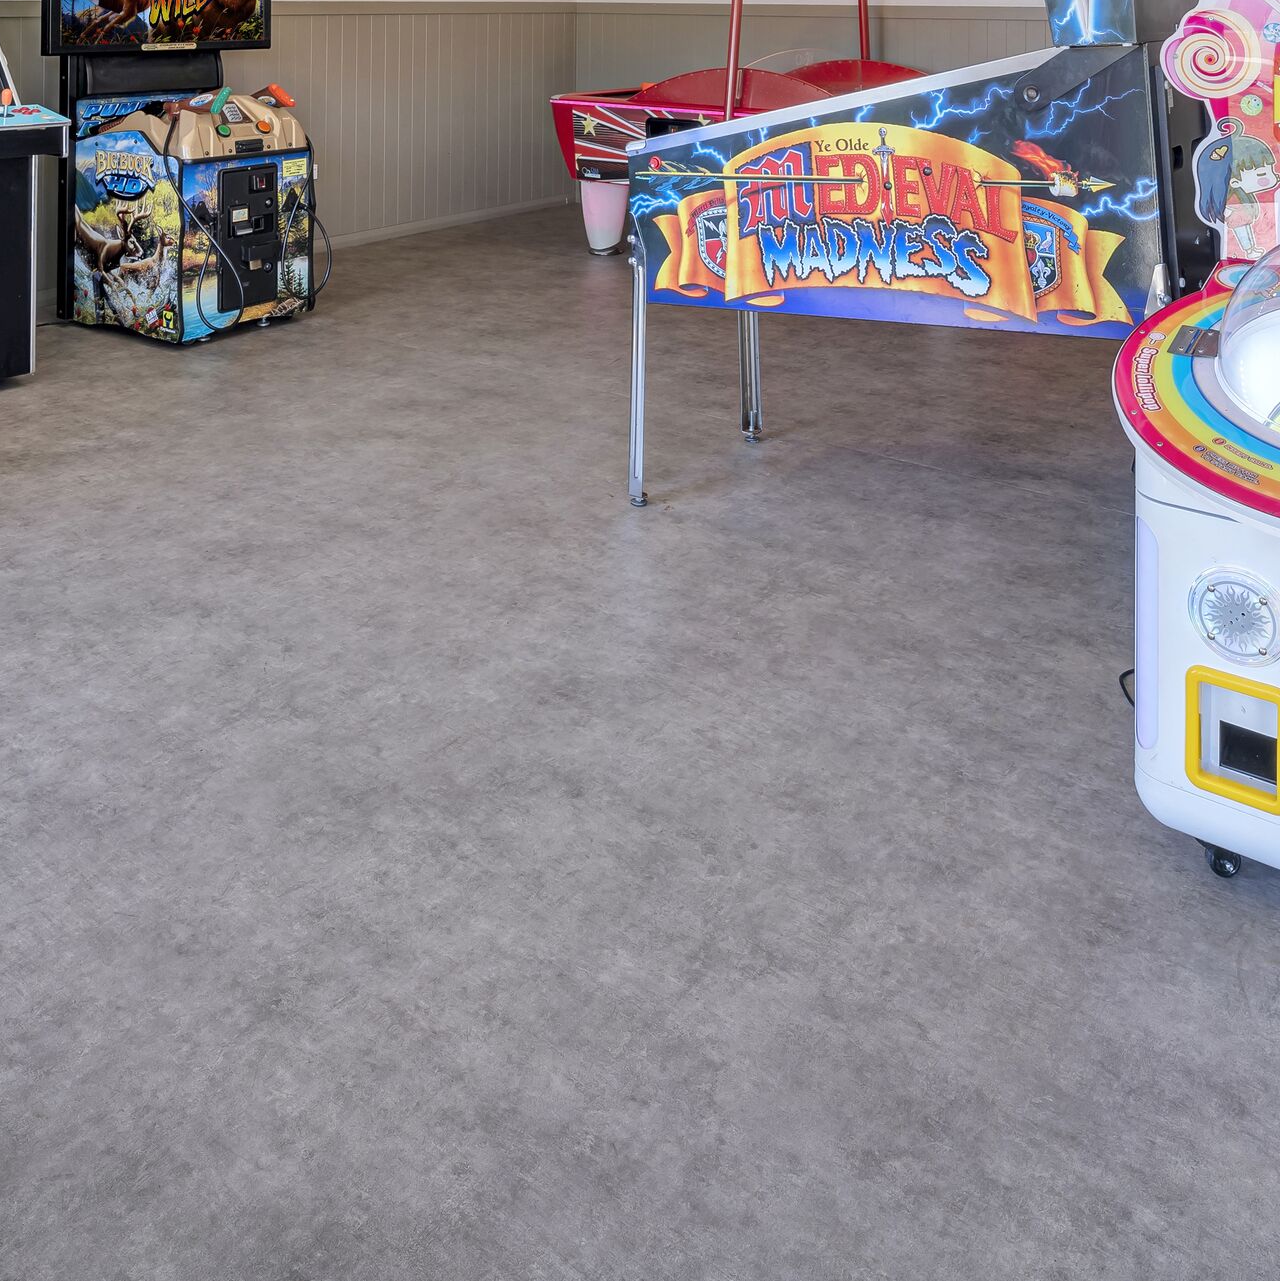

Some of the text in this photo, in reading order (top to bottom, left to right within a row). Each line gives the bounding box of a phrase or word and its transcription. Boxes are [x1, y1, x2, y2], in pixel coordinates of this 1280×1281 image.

[814, 138, 869, 152] Ye Olde
[96, 150, 155, 179] BIG BUCK
[106, 176, 145, 194] HD
[738, 149, 1019, 243] MEDIEVAL
[757, 214, 991, 297] MADNESS
[1134, 347, 1158, 373] Super
[1135, 374, 1161, 410] lollipop
